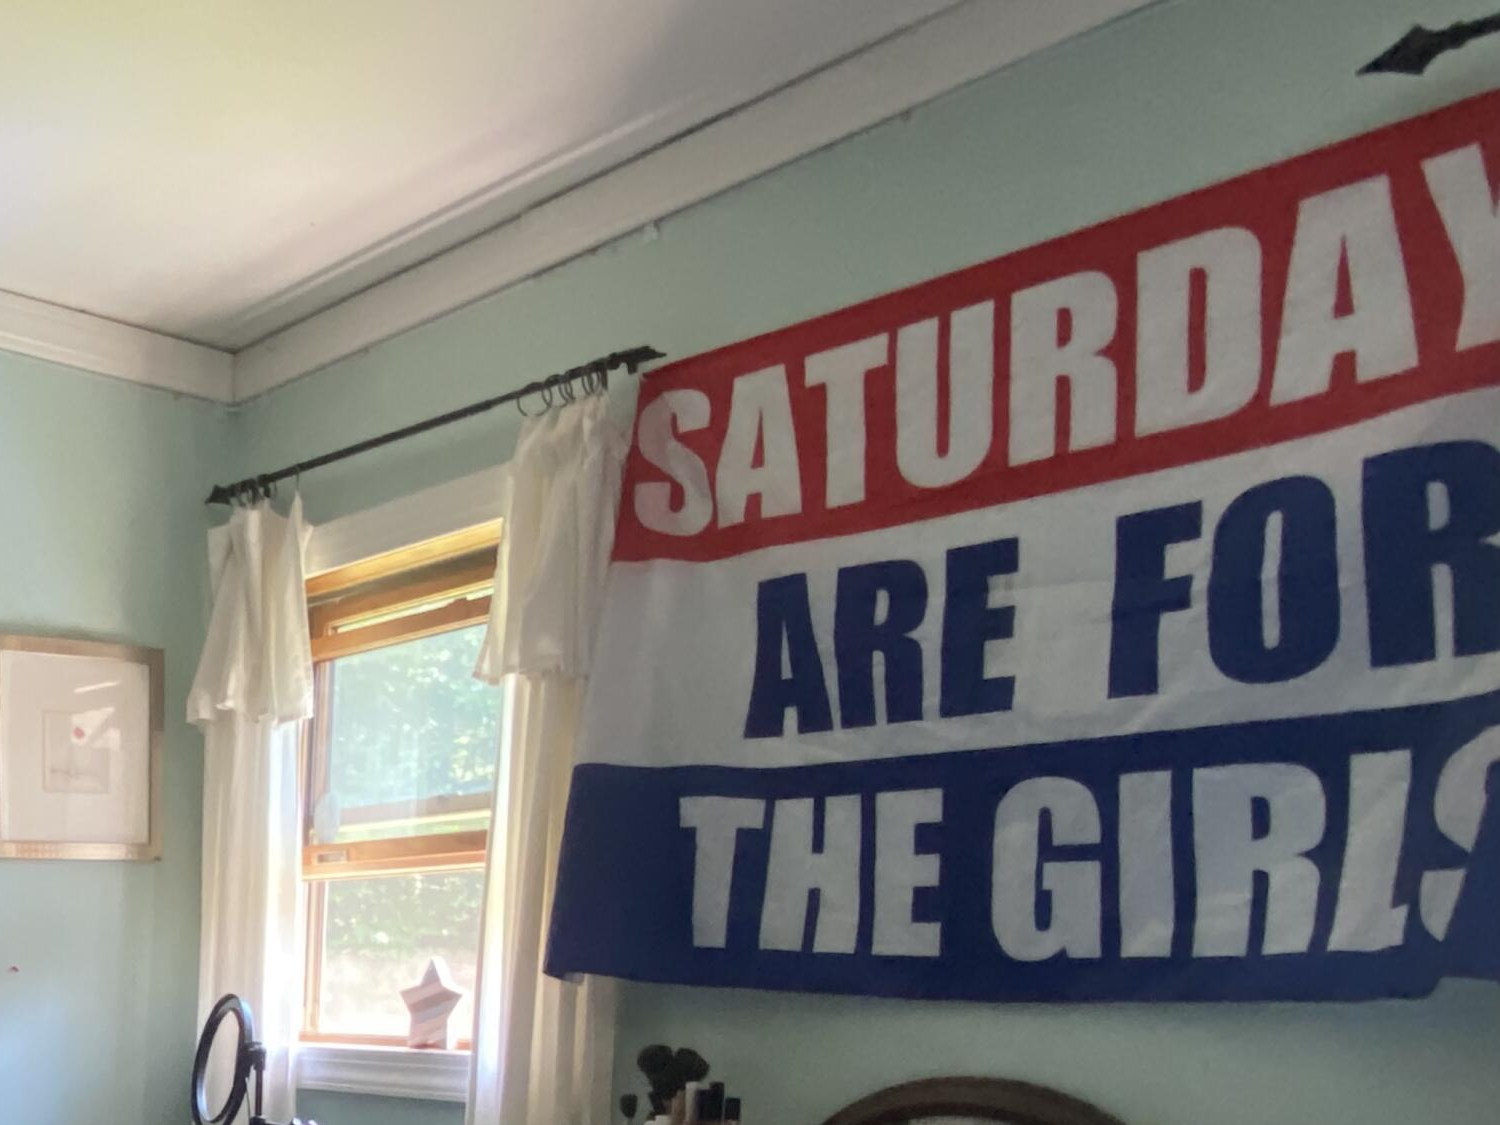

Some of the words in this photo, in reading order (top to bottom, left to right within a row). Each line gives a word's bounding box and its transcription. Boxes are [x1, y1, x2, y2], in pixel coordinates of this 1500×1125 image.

[743, 537, 1021, 740] ARE
[1107, 440, 1500, 699] FOR
[679, 789, 943, 957] THE
